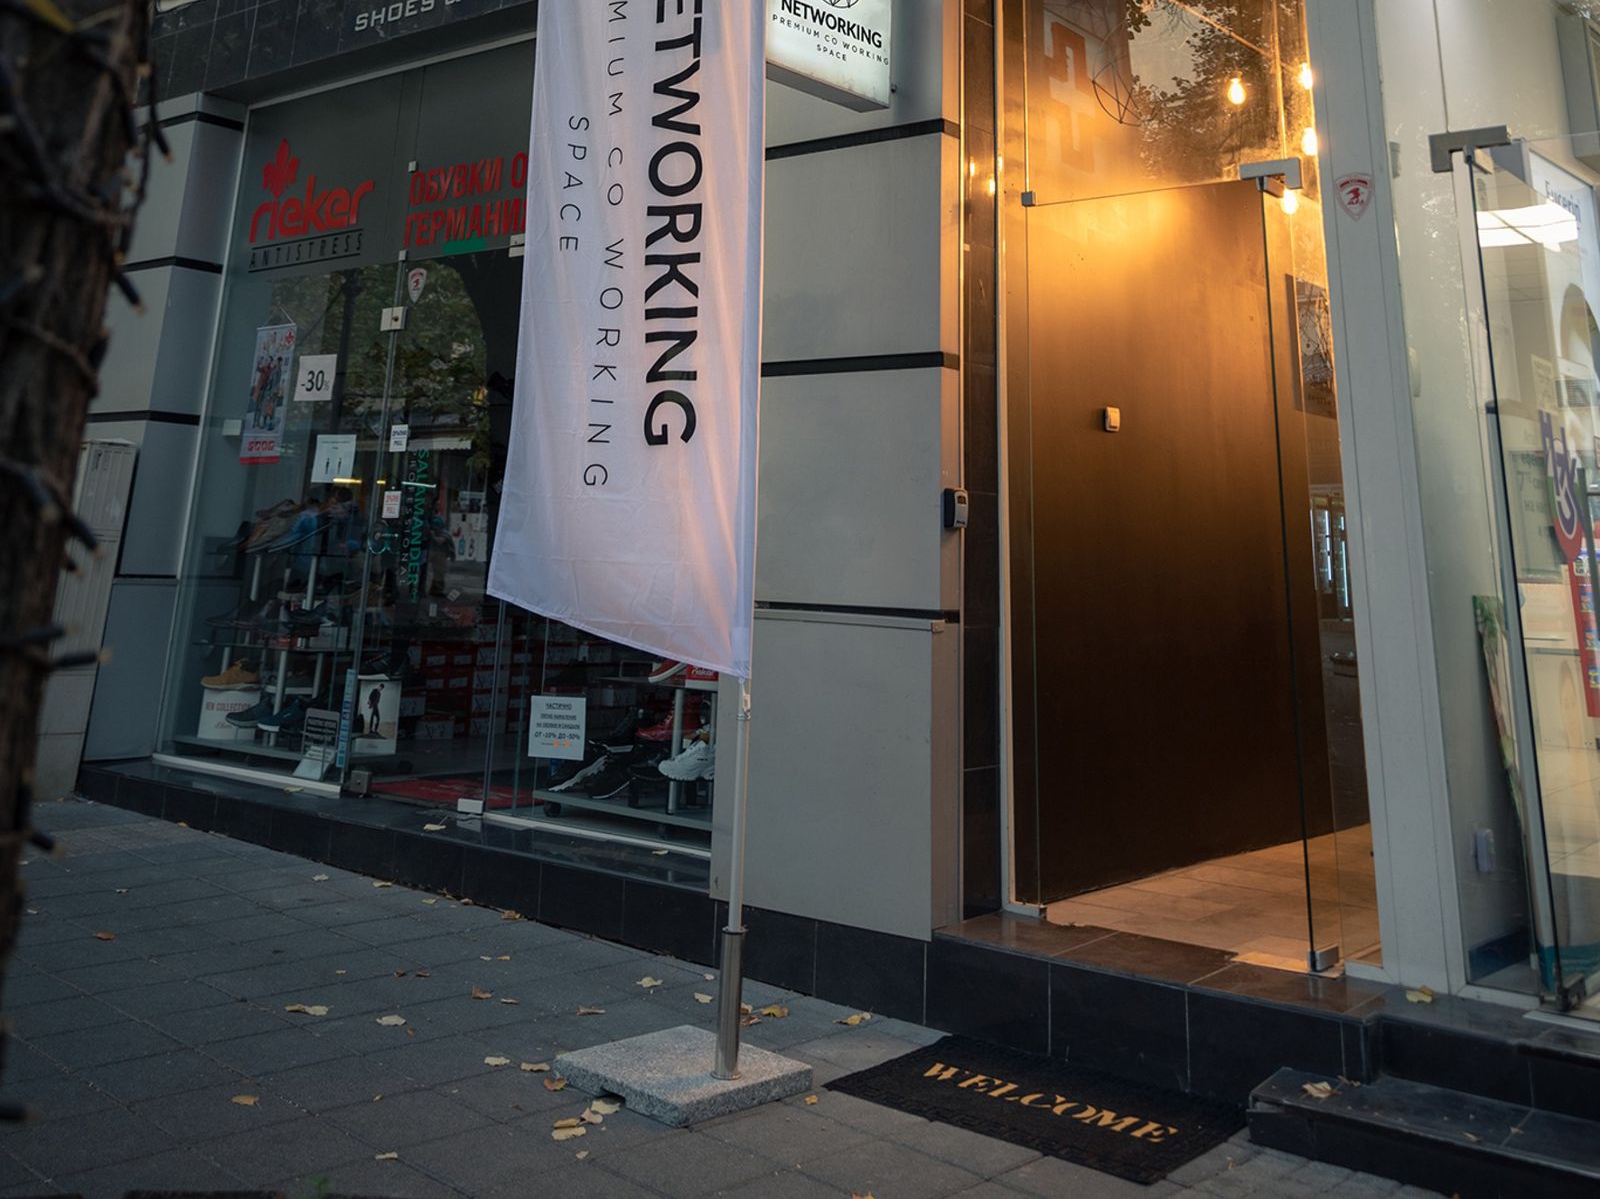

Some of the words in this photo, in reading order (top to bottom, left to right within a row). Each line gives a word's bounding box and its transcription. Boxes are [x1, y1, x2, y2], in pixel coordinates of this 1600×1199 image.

[772, 14, 820, 38] PREMIUM
[824, 34, 838, 46] CO
[842, 40, 889, 65] WORKING
[816, 44, 847, 62] SPACE
[248, 174, 375, 243] rieker
[409, 156, 504, 206] ОБУВКИ
[511, 151, 528, 189] О
[559, 115, 590, 251] SPACE
[607, 147, 624, 206] CO
[249, 233, 363, 269] ANTISTRESS
[583, 238, 624, 486] WORKING
[407, 449, 430, 586] SALAMANDER
[922, 1062, 1179, 1142] WELCOME
